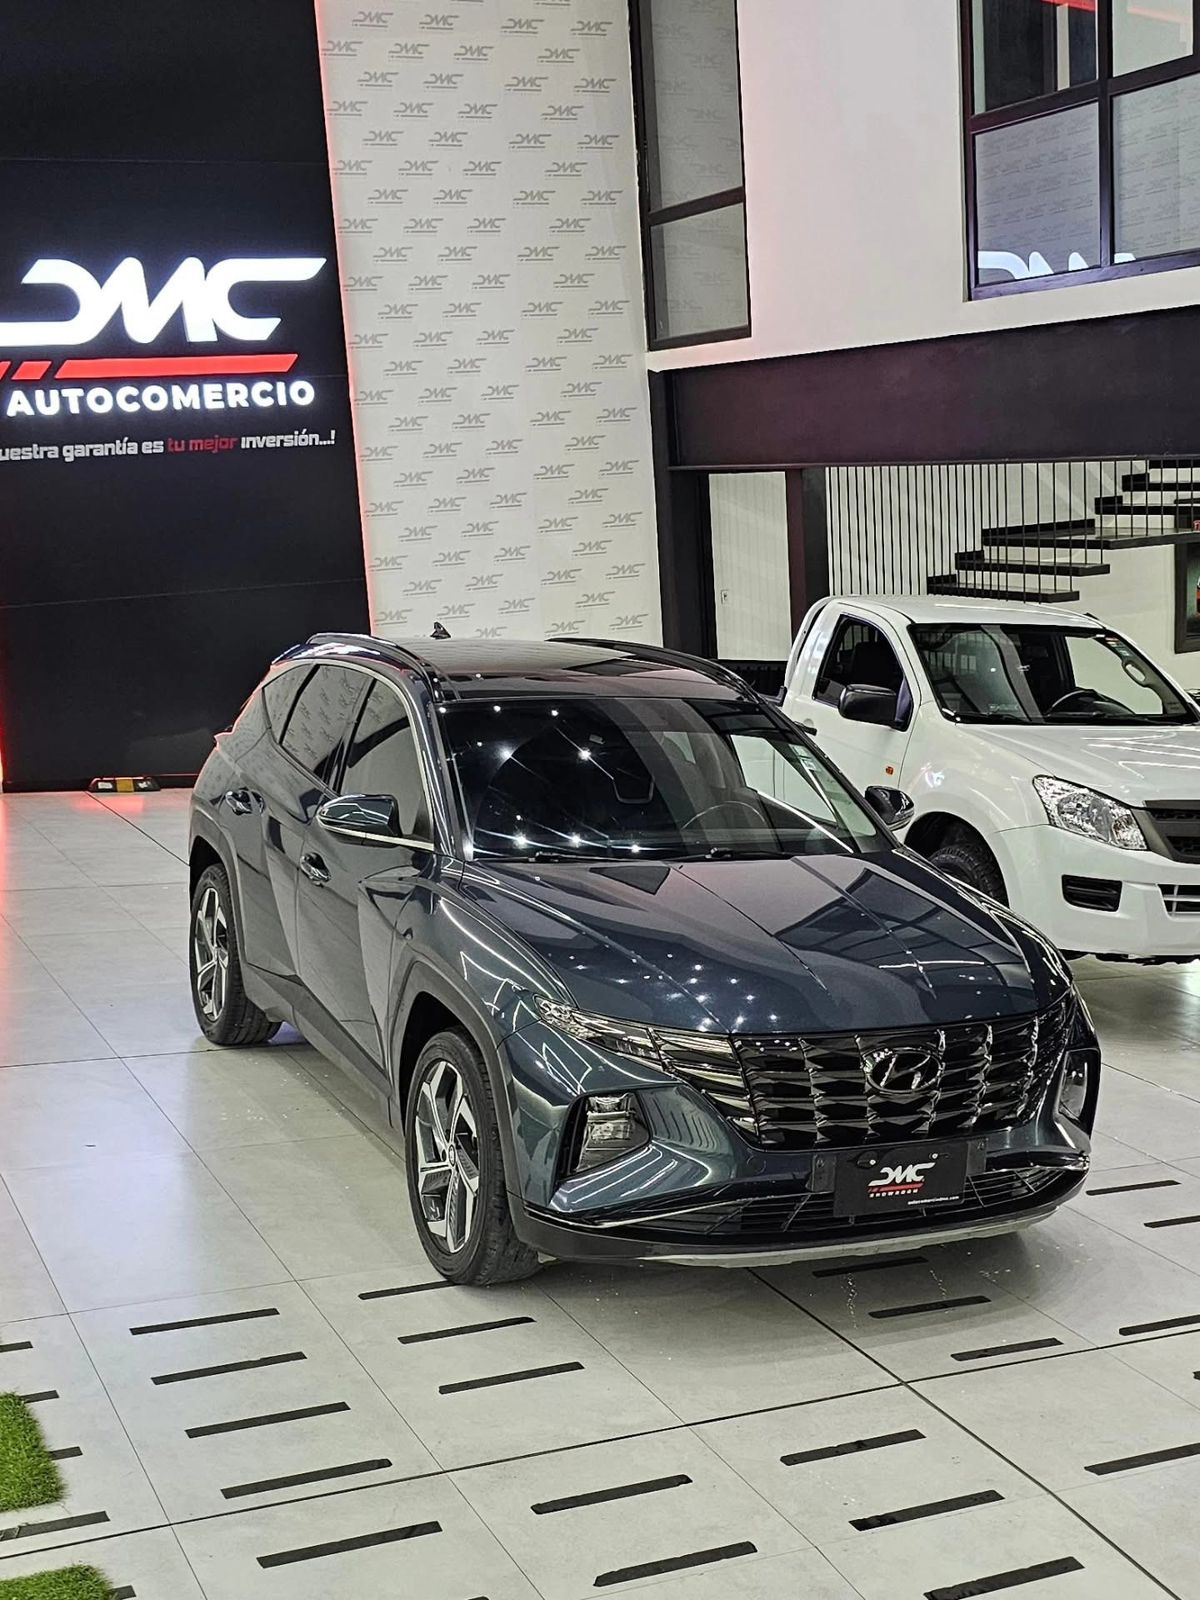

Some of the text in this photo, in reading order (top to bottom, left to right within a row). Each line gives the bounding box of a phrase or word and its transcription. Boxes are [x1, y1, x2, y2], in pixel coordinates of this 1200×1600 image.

[352, 11, 394, 23] DMC
[419, 14, 459, 26] DMC
[501, 18, 544, 29] DMC
[570, 21, 613, 32] DMC
[321, 41, 363, 52] DMC
[388, 43, 430, 54] DMC
[454, 45, 494, 57] DMC
[538, 48, 580, 59] DMC
[357, 72, 399, 83] DMC
[423, 73, 464, 85] DMC
[504, 76, 549, 87] DMC
[574, 78, 616, 89] DMC
[327, 101, 368, 112] DMC
[393, 102, 434, 113] DMC
[458, 104, 498, 114] DMC
[541, 105, 584, 116] DMC
[363, 131, 404, 142] DMC
[428, 131, 468, 142] DMC
[509, 134, 552, 144] DMC
[577, 135, 620, 145] DMC
[332, 160, 372, 171] DMC
[398, 160, 439, 171] DMC
[463, 161, 502, 172] DMC
[544, 162, 588, 172] DMC
[368, 189, 408, 200] DMC
[433, 189, 473, 200] DMC
[513, 190, 556, 201] DMC
[580, 190, 623, 201] DMC
[338, 218, 378, 229] DMC
[403, 218, 443, 229] DMC
[467, 218, 506, 229] DMC
[549, 218, 591, 229] DMC
[373, 247, 413, 258] DMC
[438, 246, 478, 257] DMC
[517, 246, 560, 257] DMC
[585, 246, 626, 256] DMC
[344, 276, 383, 287] DMC
[408, 275, 448, 286] DMC
[472, 274, 511, 285] DMC
[553, 273, 595, 284] DMC
[0, 257, 327, 346] DMC
[442, 302, 482, 313] DMC
[521, 302, 564, 313] DMC
[588, 300, 630, 311] DMC
[378, 304, 418, 315] DMC
[349, 333, 389, 344] DMC
[413, 331, 453, 343] DMC
[477, 329, 515, 341] DMC
[557, 328, 599, 339] DMC
[447, 358, 487, 370] DMC
[525, 356, 567, 368] DMC
[592, 354, 632, 365] DMC
[384, 361, 423, 372] DMC
[418, 387, 457, 399] DMC
[481, 384, 519, 396] DMC
[561, 382, 602, 394] DMC
[7, 380, 315, 416] AUTOCOMERCIO
[354, 390, 393, 401] DMC
[452, 413, 491, 425] DMC
[530, 410, 571, 422] DMC
[596, 407, 637, 419] DMC
[388, 416, 428, 428] DMC
[62, 437, 138, 462] garantía
[141, 440, 164, 453] es
[167, 437, 185, 453] tu
[189, 434, 239, 454] mejor
[241, 428, 336, 449] inversión...!
[486, 439, 523, 451] DMC
[565, 435, 606, 447] DMC
[360, 446, 398, 457] DMC
[423, 442, 462, 455] DMC
[533, 464, 575, 476] DMC
[599, 460, 640, 472] DMC
[393, 471, 433, 483] DMC
[456, 467, 495, 480] DMC
[489, 492, 527, 505] DMC
[568, 488, 609, 501] DMC
[364, 501, 403, 513] DMC
[428, 497, 467, 509] DMC
[538, 516, 578, 529] DMC
[602, 512, 642, 524] DMC
[398, 525, 438, 538] DMC
[461, 521, 499, 533] DMC
[494, 545, 531, 558] DMC
[572, 540, 612, 552] DMC
[369, 555, 408, 568] DMC
[432, 550, 471, 563] DMC
[541, 569, 582, 582] DMC
[605, 563, 646, 576] DMC
[403, 579, 442, 592] DMC
[465, 574, 503, 587] DMC
[575, 591, 615, 604] DMC
[437, 603, 475, 616] DMC
[498, 598, 536, 610] DMC
[374, 609, 413, 622] DMC
[609, 614, 648, 627] DMC
[472, 626, 508, 638] DMC
[544, 620, 585, 633] DMC
[868, 1162, 936, 1186] DMC
